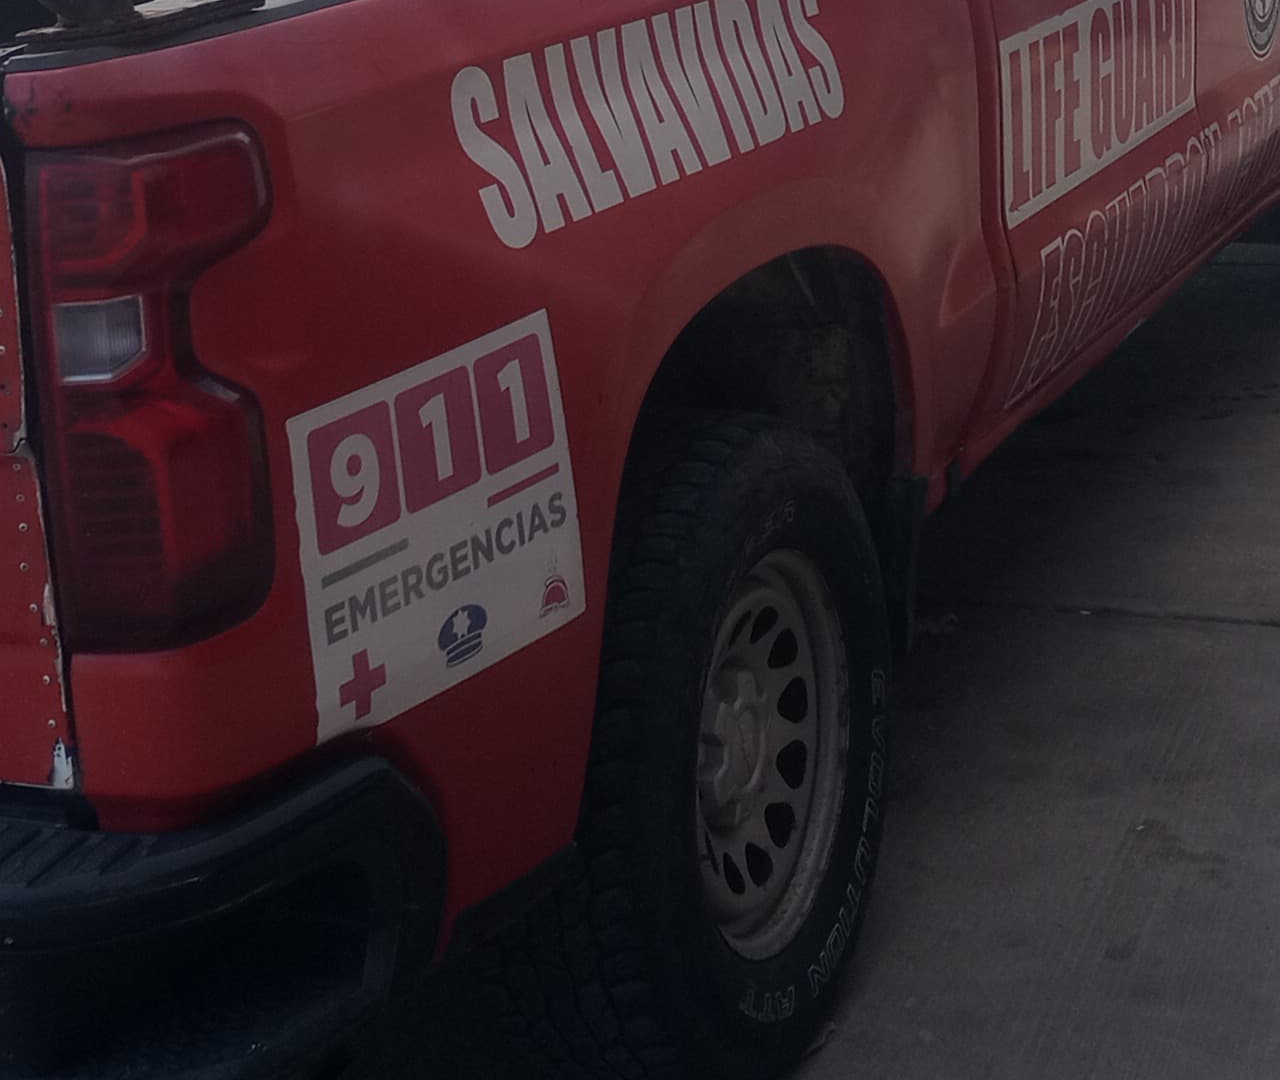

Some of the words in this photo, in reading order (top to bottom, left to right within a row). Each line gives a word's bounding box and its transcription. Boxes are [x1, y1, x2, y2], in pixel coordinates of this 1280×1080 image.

[1008, 20, 1082, 213] LIFE
[330, 359, 531, 527] 911
[325, 492, 567, 645] EMERGENCIAS
